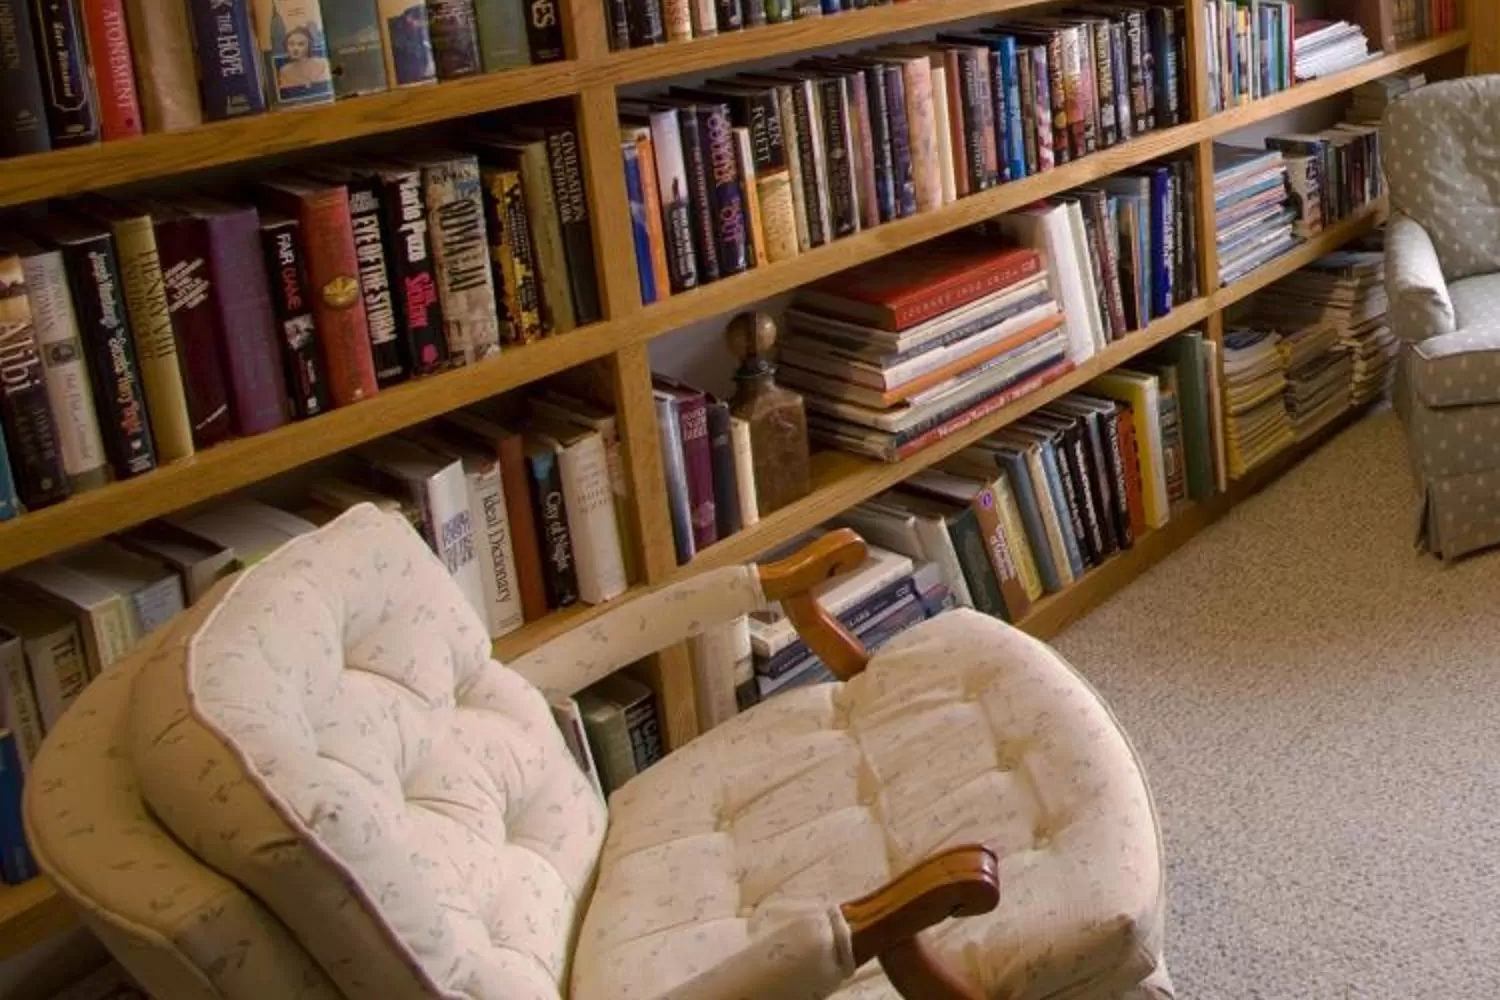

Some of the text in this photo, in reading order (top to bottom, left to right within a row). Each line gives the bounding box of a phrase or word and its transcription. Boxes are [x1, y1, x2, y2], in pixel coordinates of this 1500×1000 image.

[217, 14, 231, 34] THE
[217, 36, 243, 77] HOPE
[104, 9, 133, 111] ATONEMENT
[751, 106, 770, 164] FOLLETT
[768, 116, 784, 148] KEN
[560, 131, 588, 223] CIVILISATION
[352, 214, 380, 244] EYE
[397, 170, 427, 262] Mario Puzo
[277, 232, 301, 310] FAIR GAME
[357, 244, 384, 264] OF
[360, 264, 389, 292] THE
[138, 249, 178, 360] HENRY VIII
[364, 291, 398, 346] STORM
[2, 319, 39, 396] Alibi
[482, 492, 512, 604] Ideal Dictionary
[545, 491, 571, 572] City of Night
